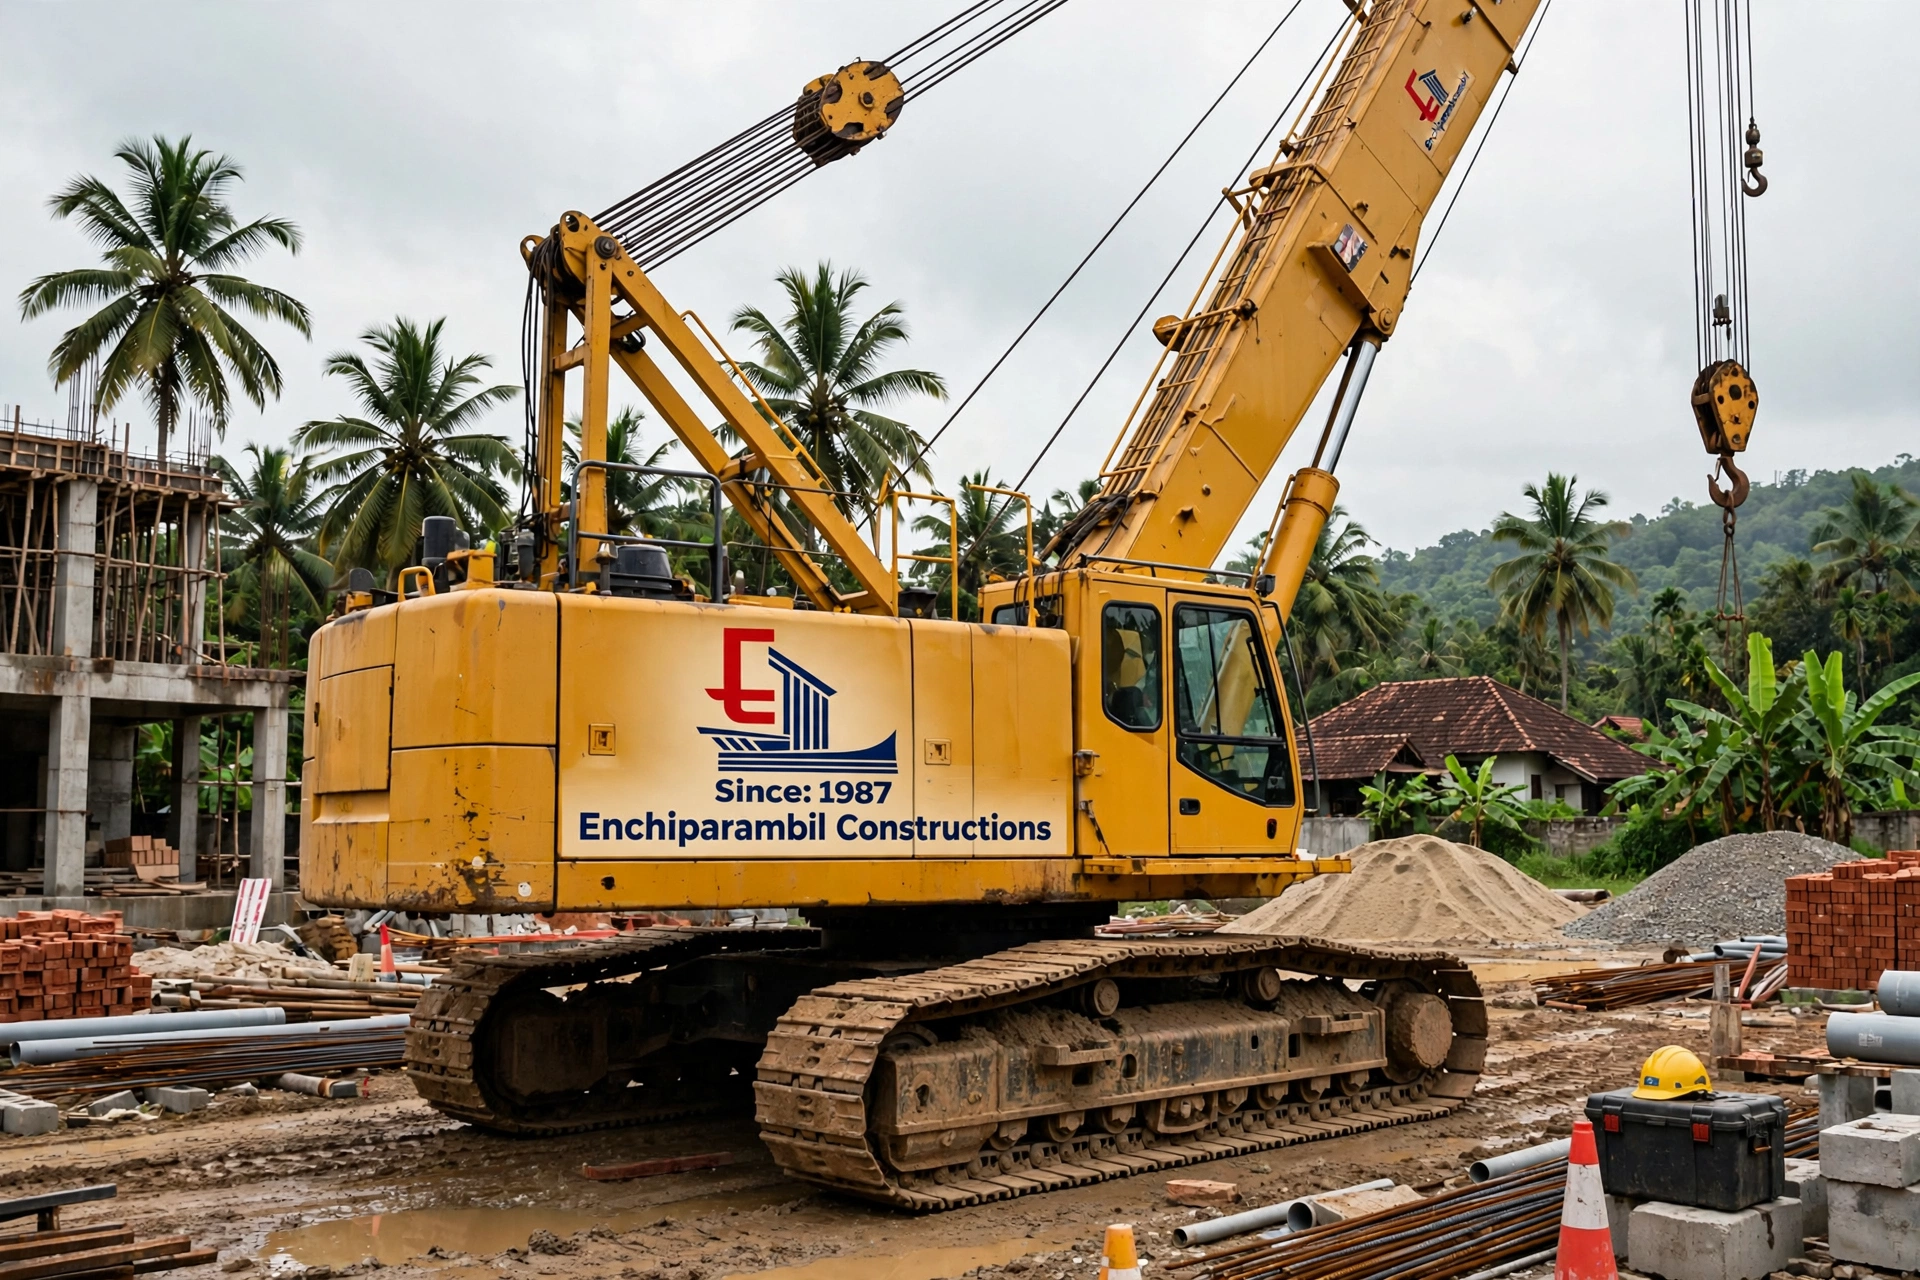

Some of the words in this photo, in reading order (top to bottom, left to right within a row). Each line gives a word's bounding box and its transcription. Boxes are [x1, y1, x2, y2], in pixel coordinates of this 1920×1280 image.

[715, 778, 811, 804] Since:
[818, 781, 892, 804] 1987
[579, 810, 825, 847] Enchiparambil
[836, 812, 1052, 841] Constructions
